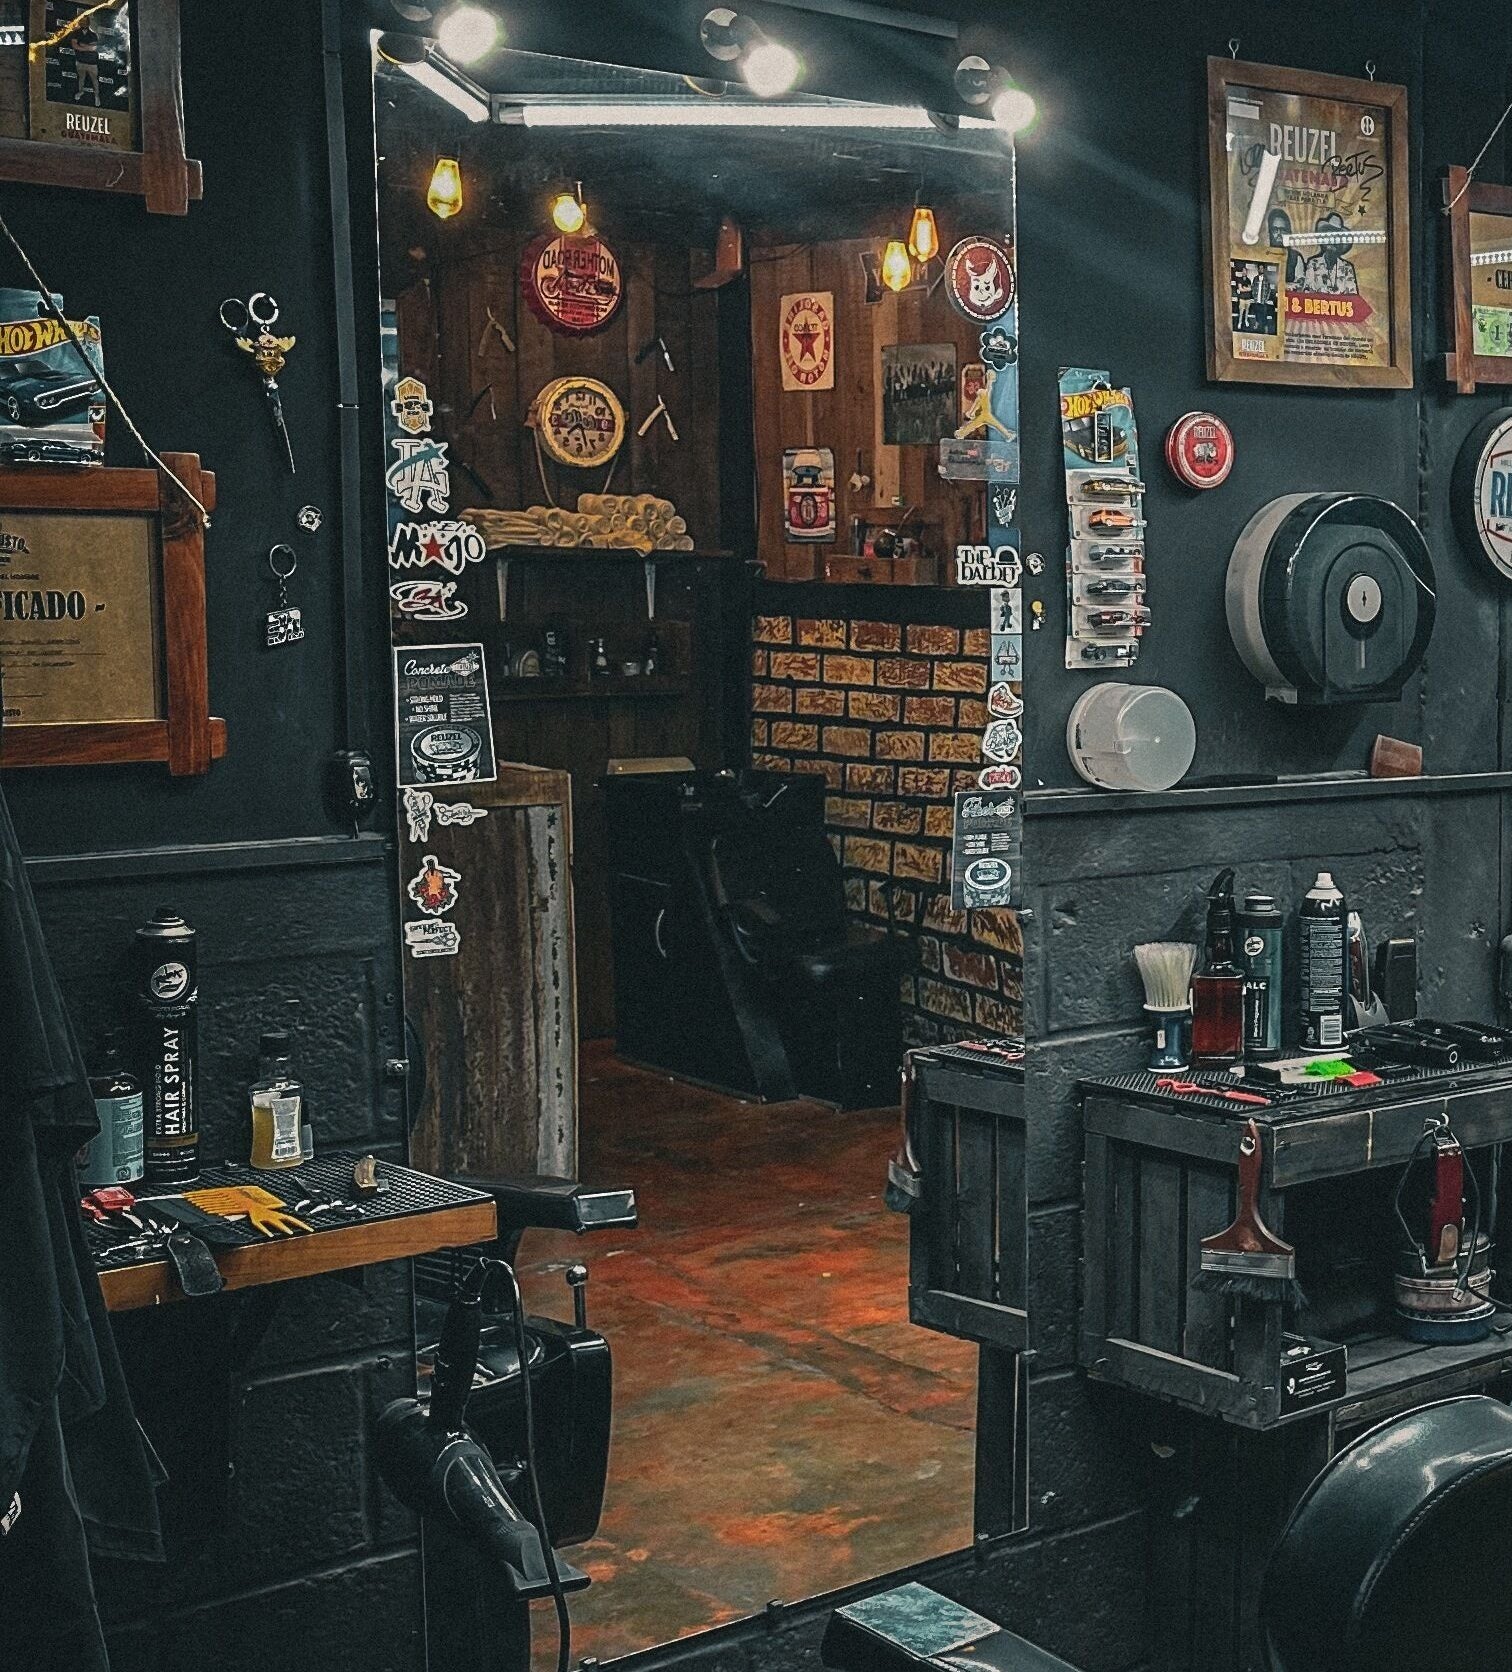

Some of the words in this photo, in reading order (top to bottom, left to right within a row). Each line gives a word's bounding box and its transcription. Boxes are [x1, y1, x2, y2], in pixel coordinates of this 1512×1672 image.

[66, 113, 111, 135] REUZEL
[1269, 122, 1337, 166] REUZEL
[1291, 297, 1302, 313] &
[1304, 298, 1354, 317] BERTUS
[1246, 981, 1267, 990] ALC
[163, 1027, 180, 1084] SPRAY
[164, 1091, 180, 1135] HAIR
